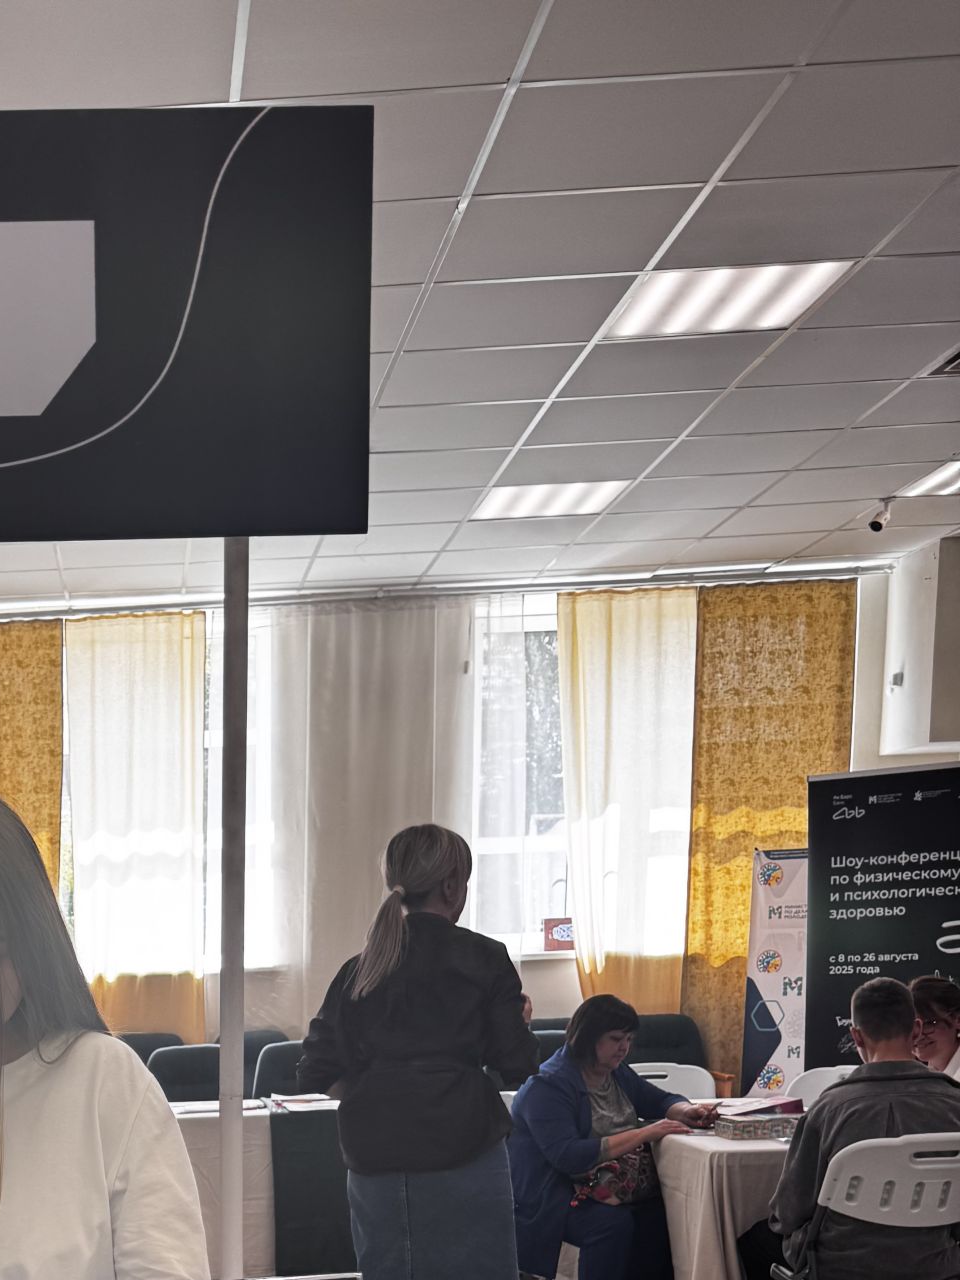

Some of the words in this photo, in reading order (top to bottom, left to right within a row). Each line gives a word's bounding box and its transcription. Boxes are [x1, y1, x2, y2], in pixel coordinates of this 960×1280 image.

[830, 875, 849, 885] по
[853, 868, 960, 886] физическому
[829, 893, 840, 902] и
[828, 906, 906, 920] здоровью
[838, 954, 845, 962] 8
[847, 954, 861, 962] по
[863, 953, 876, 962] 26
[878, 953, 919, 962] августа
[829, 966, 854, 974] 2025
[856, 966, 880, 974] года
